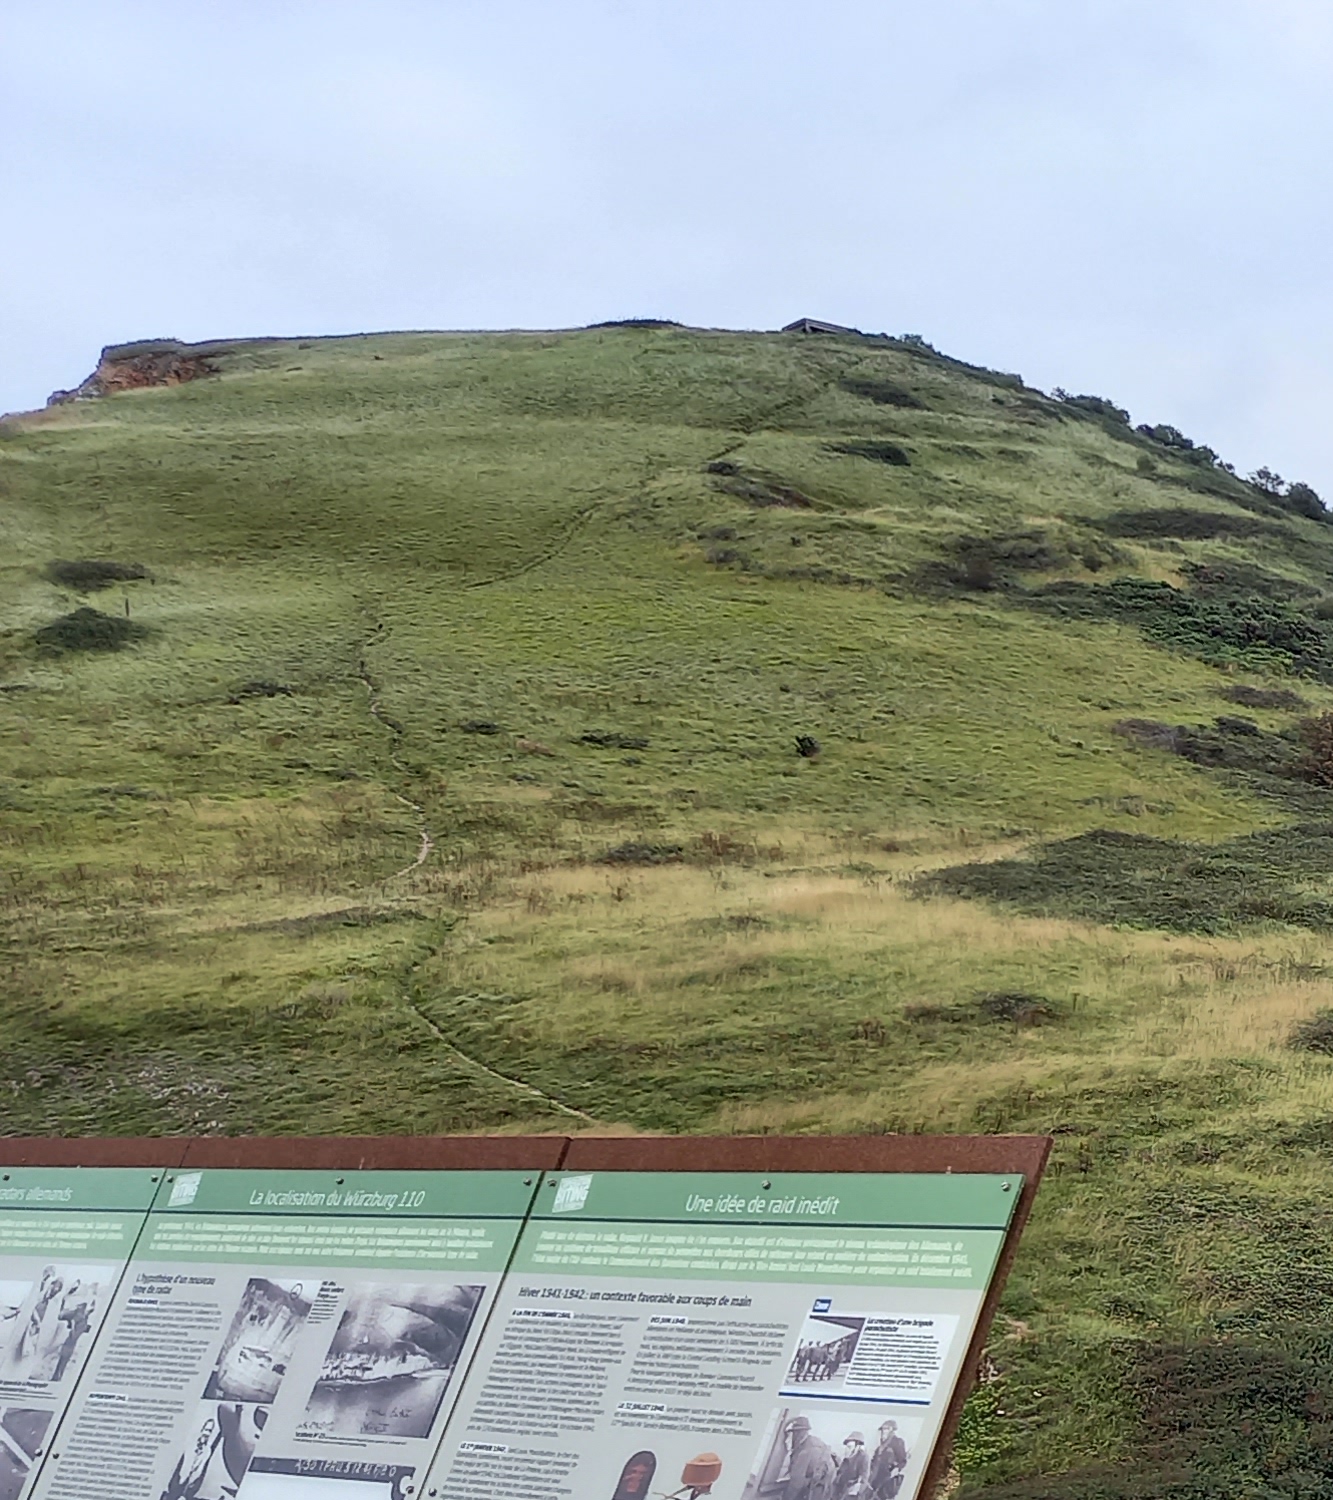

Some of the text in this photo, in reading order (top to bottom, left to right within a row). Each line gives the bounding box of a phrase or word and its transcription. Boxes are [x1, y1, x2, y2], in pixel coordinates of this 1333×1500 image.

[25, 1187, 73, 1202] allemands
[250, 1190, 426, 1211] La localisation du Würzburg 110
[685, 1194, 841, 1215] Une idée de raid inédit
[589, 1290, 601, 1301] un
[601, 1291, 636, 1303] contexte
[637, 1290, 676, 1305] favorable
[676, 1294, 692, 1305] aux
[692, 1295, 718, 1308] coups
[718, 1294, 730, 1306] de
[730, 1294, 752, 1307] main
